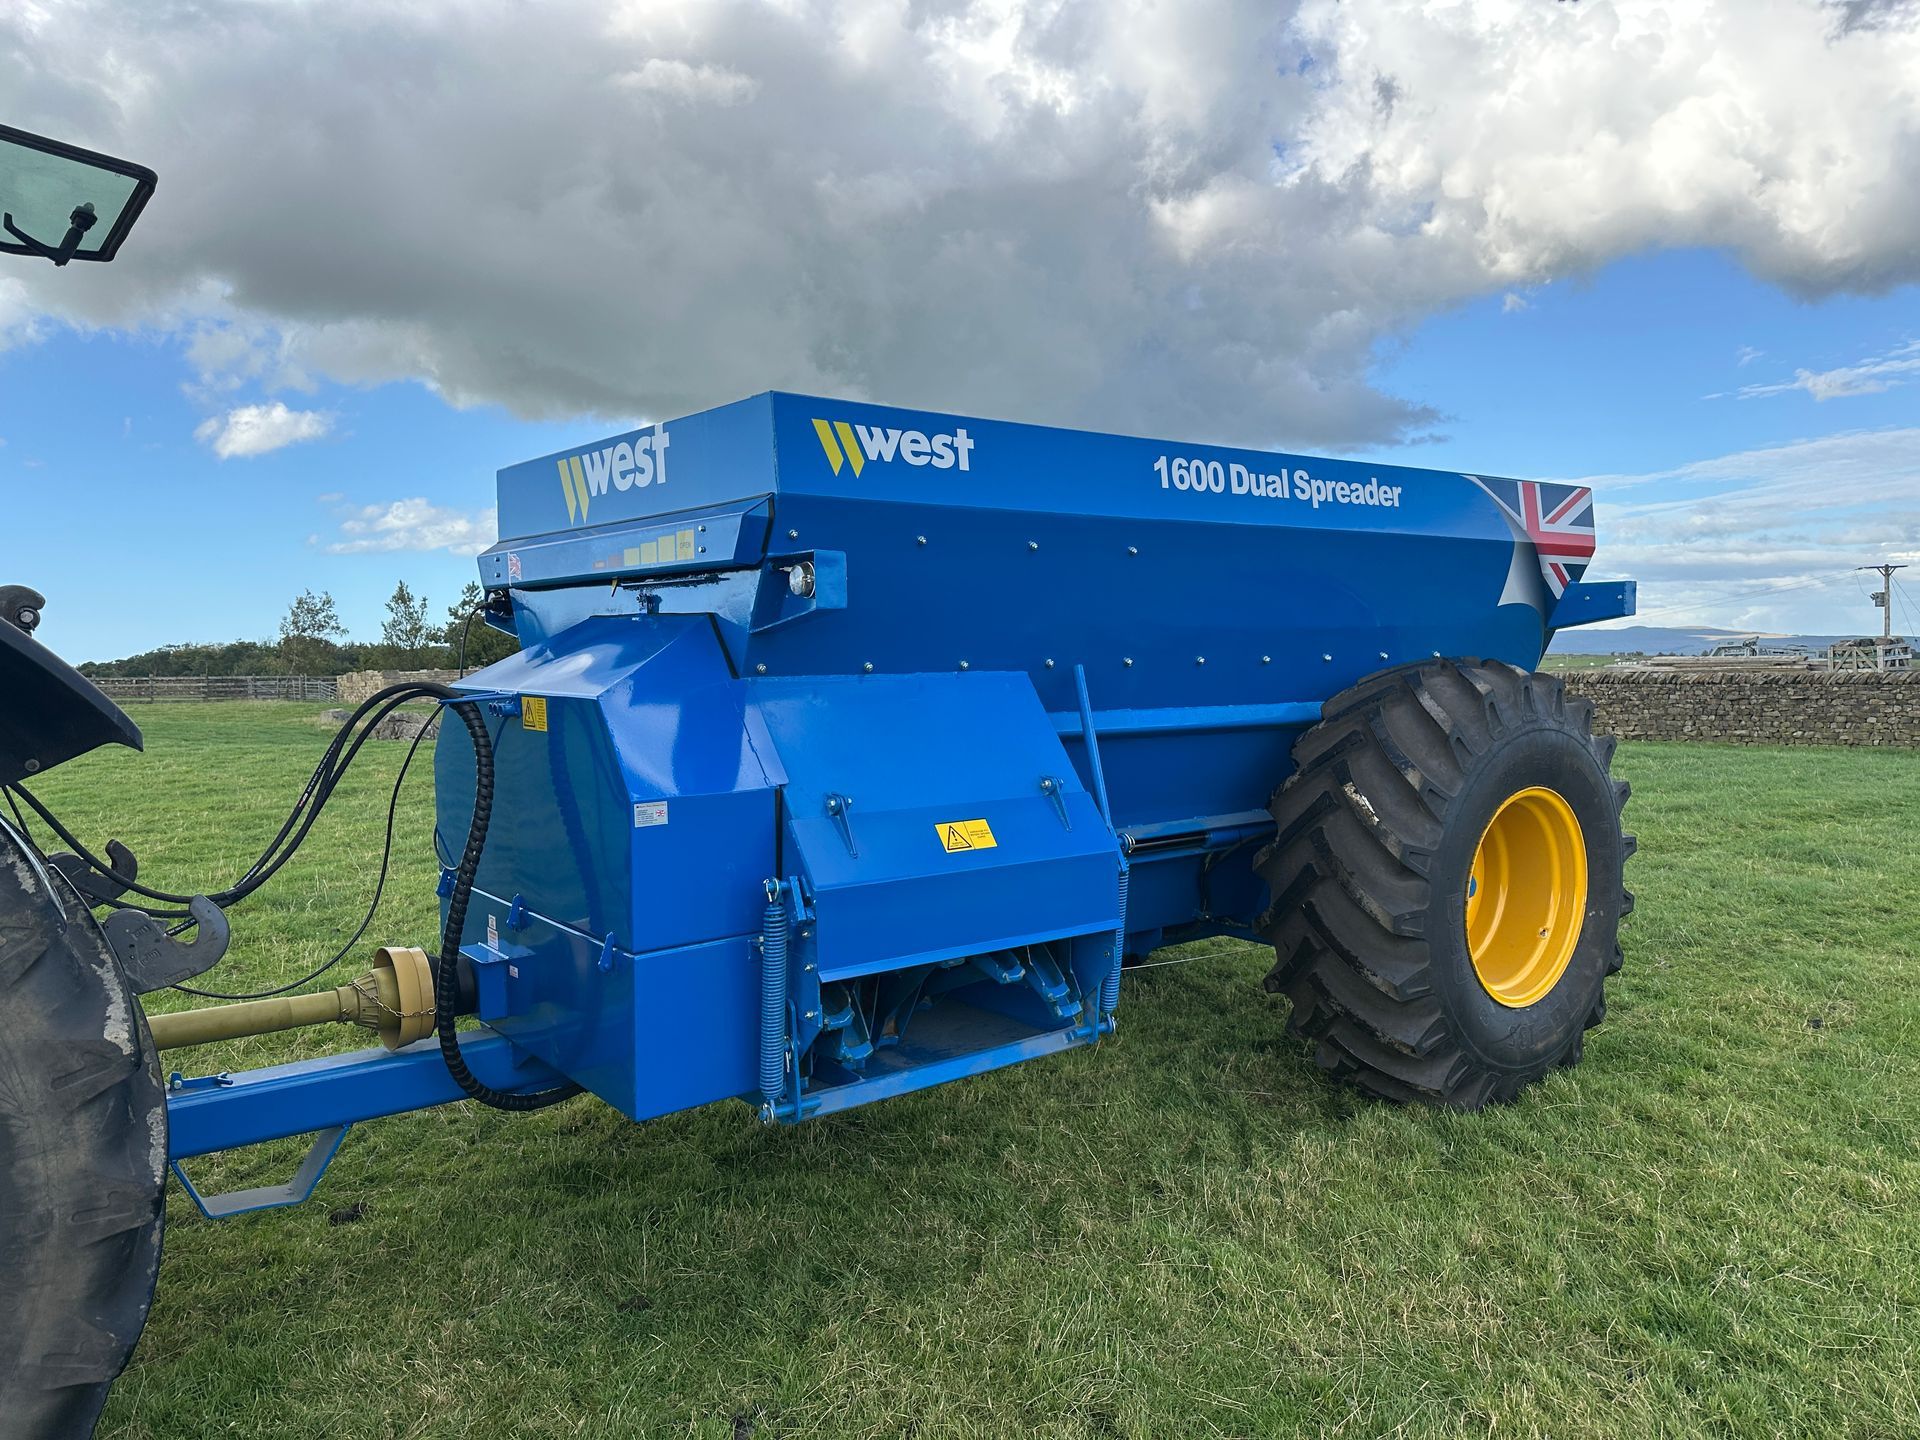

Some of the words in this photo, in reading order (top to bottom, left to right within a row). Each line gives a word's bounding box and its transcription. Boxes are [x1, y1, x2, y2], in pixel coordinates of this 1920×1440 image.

[582, 422, 671, 497] west
[854, 424, 975, 472] west
[1153, 455, 1225, 494] 1600
[1229, 463, 1290, 499] Dual
[1293, 470, 1402, 508] Spreader
